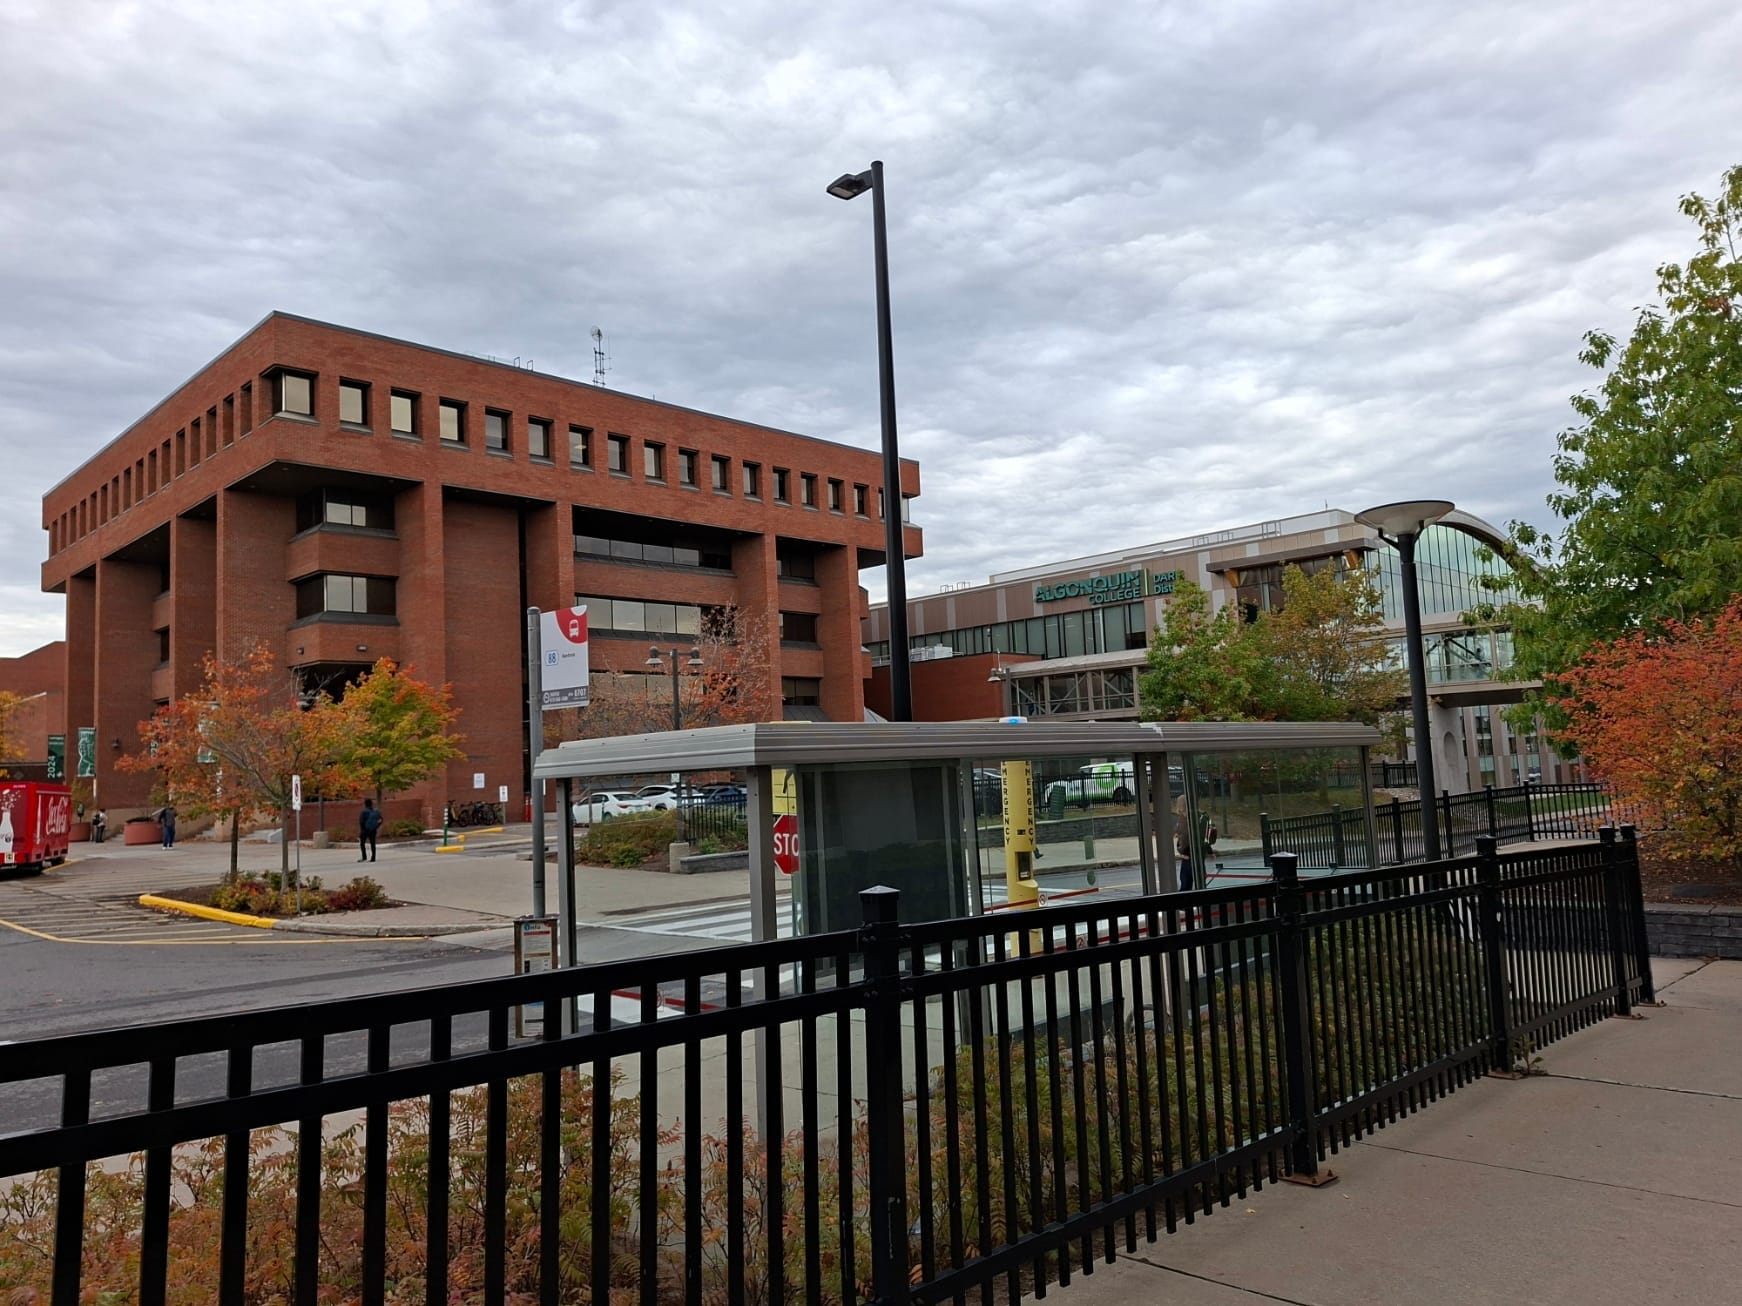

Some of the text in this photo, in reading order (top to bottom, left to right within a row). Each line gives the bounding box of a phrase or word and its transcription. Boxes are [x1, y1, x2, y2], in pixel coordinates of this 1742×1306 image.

[1035, 570, 1141, 602] ALGONQUIN
[1089, 588, 1141, 605] COLLEGE
[48, 755, 56, 778] 2024
